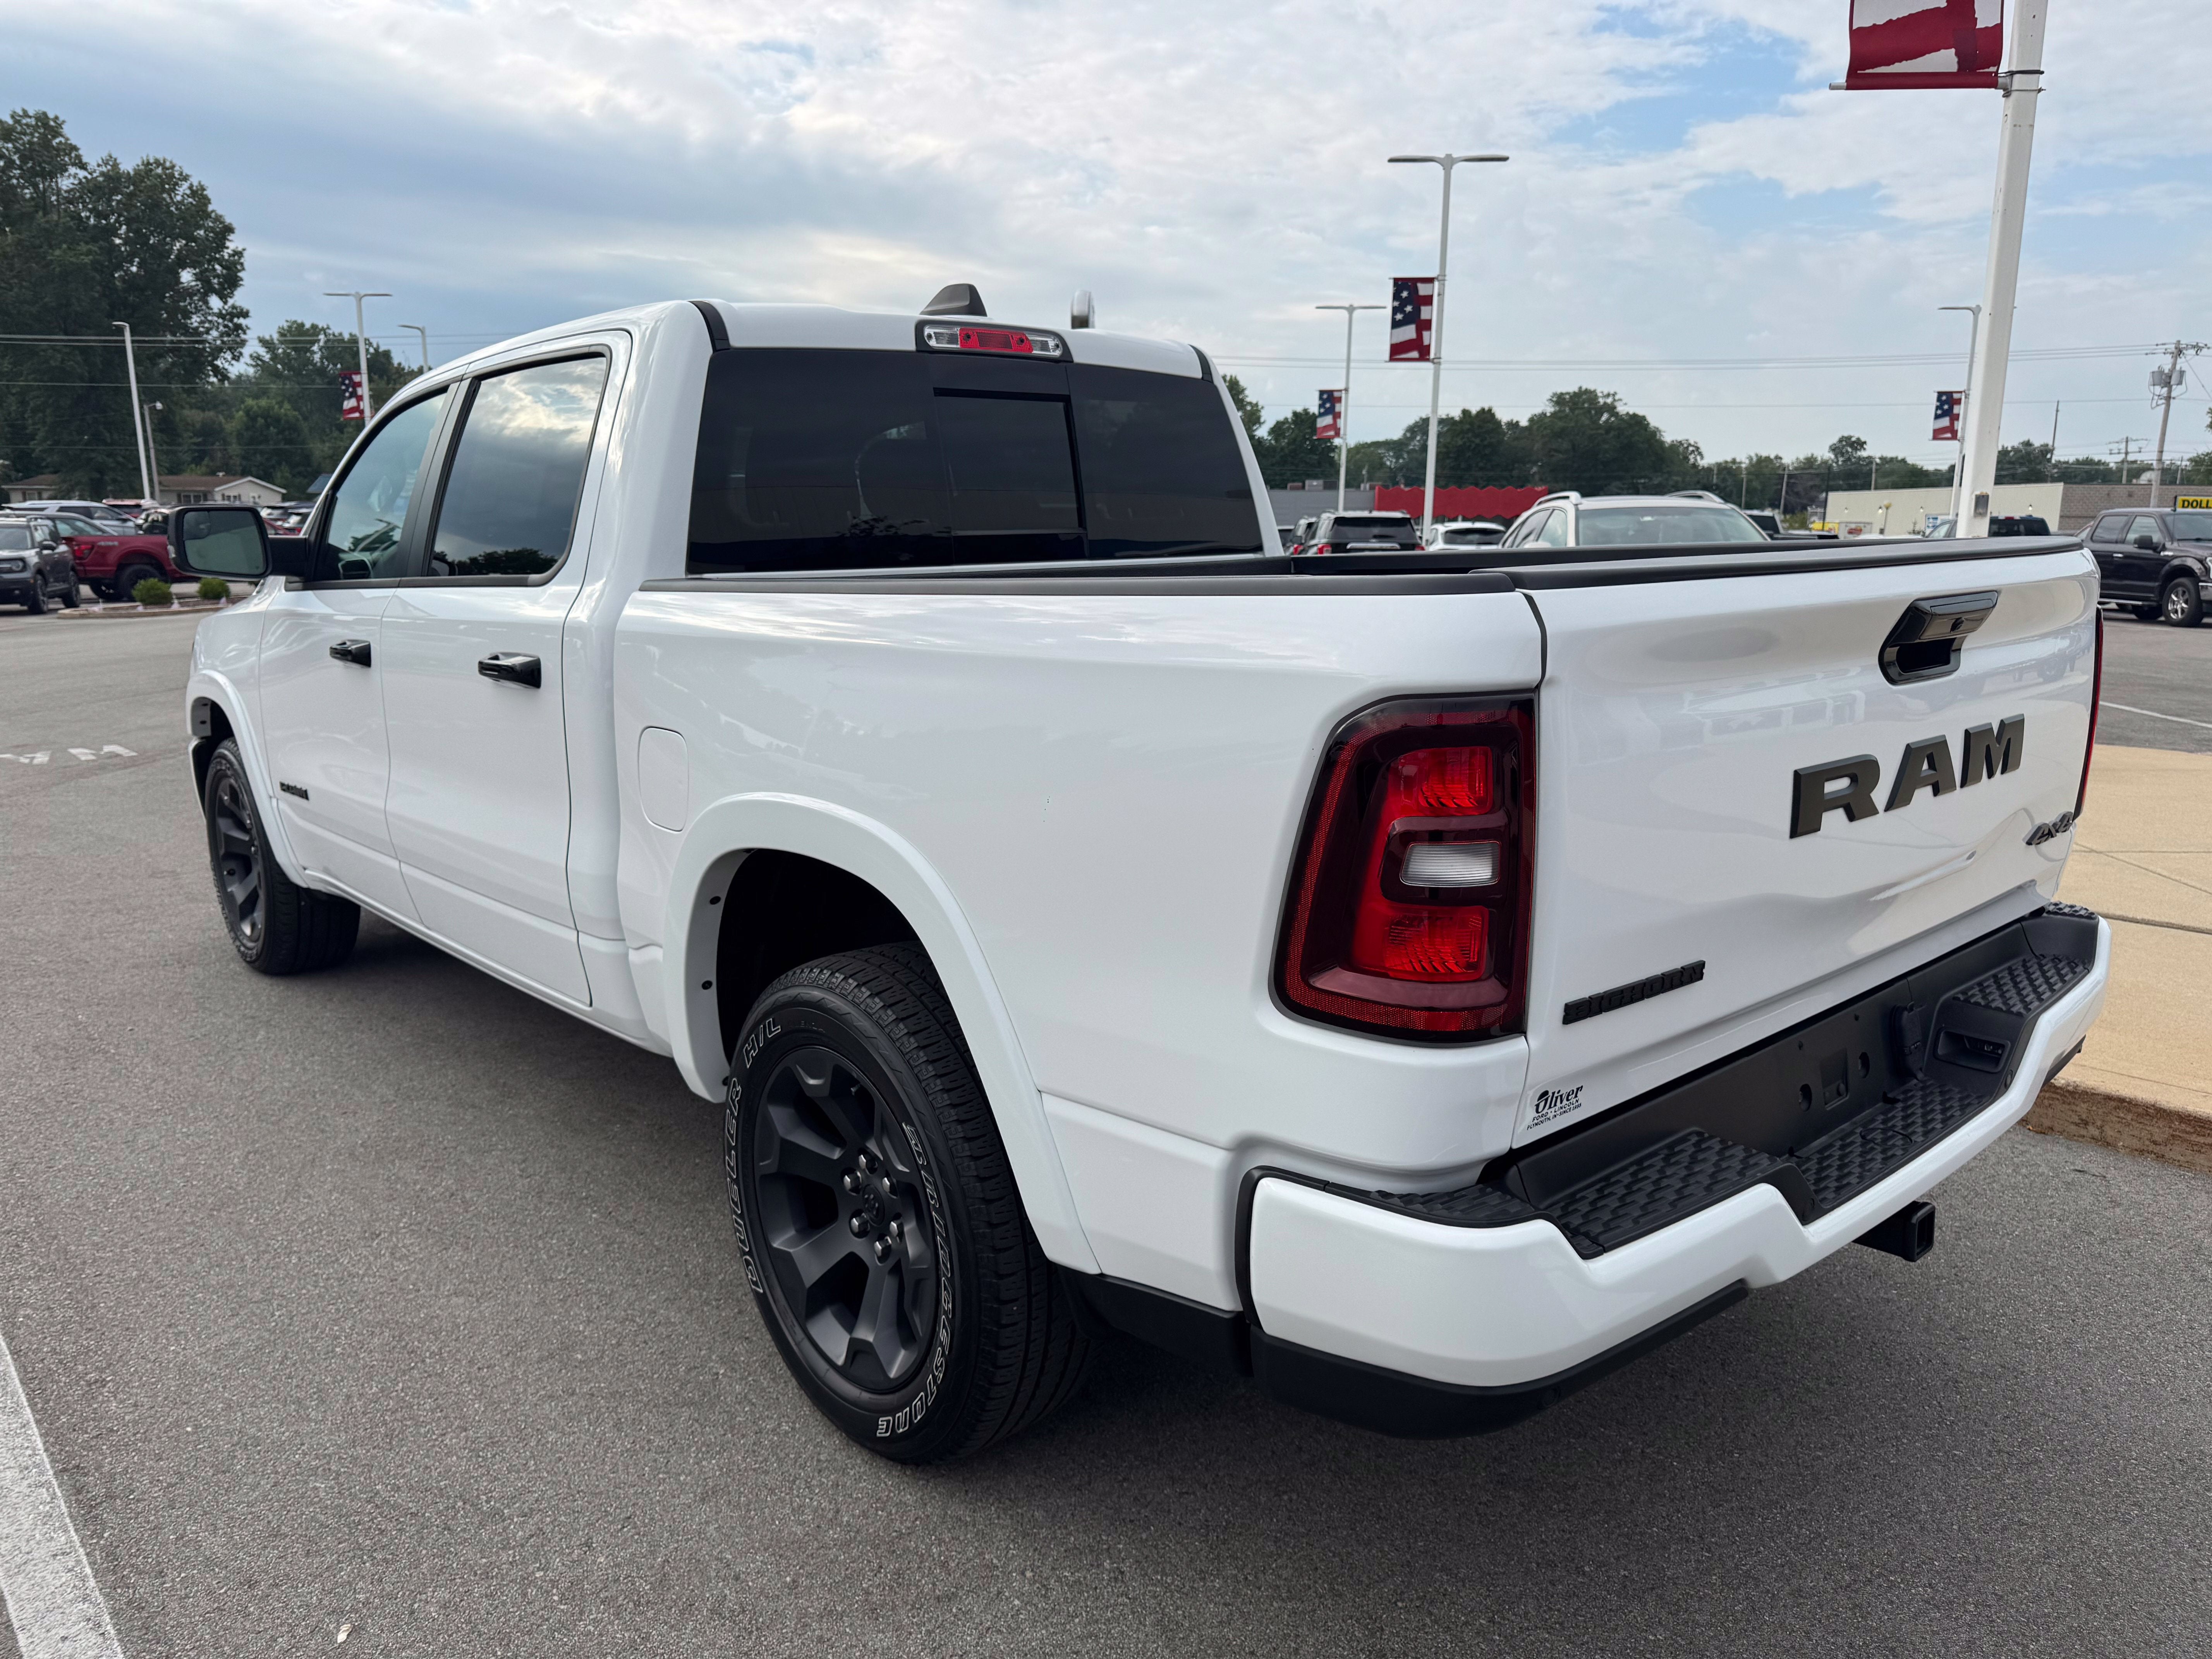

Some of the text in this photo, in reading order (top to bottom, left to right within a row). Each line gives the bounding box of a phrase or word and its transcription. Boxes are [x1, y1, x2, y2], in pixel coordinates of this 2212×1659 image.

[1789, 713, 2025, 839] RAM
[725, 1017, 781, 1293] DUELER H/L
[1532, 1098, 1579, 1123] FORD LINCOLN
[1534, 1085, 1583, 1114] Oliver
[876, 1121, 953, 1437] BRIDGESTONE
